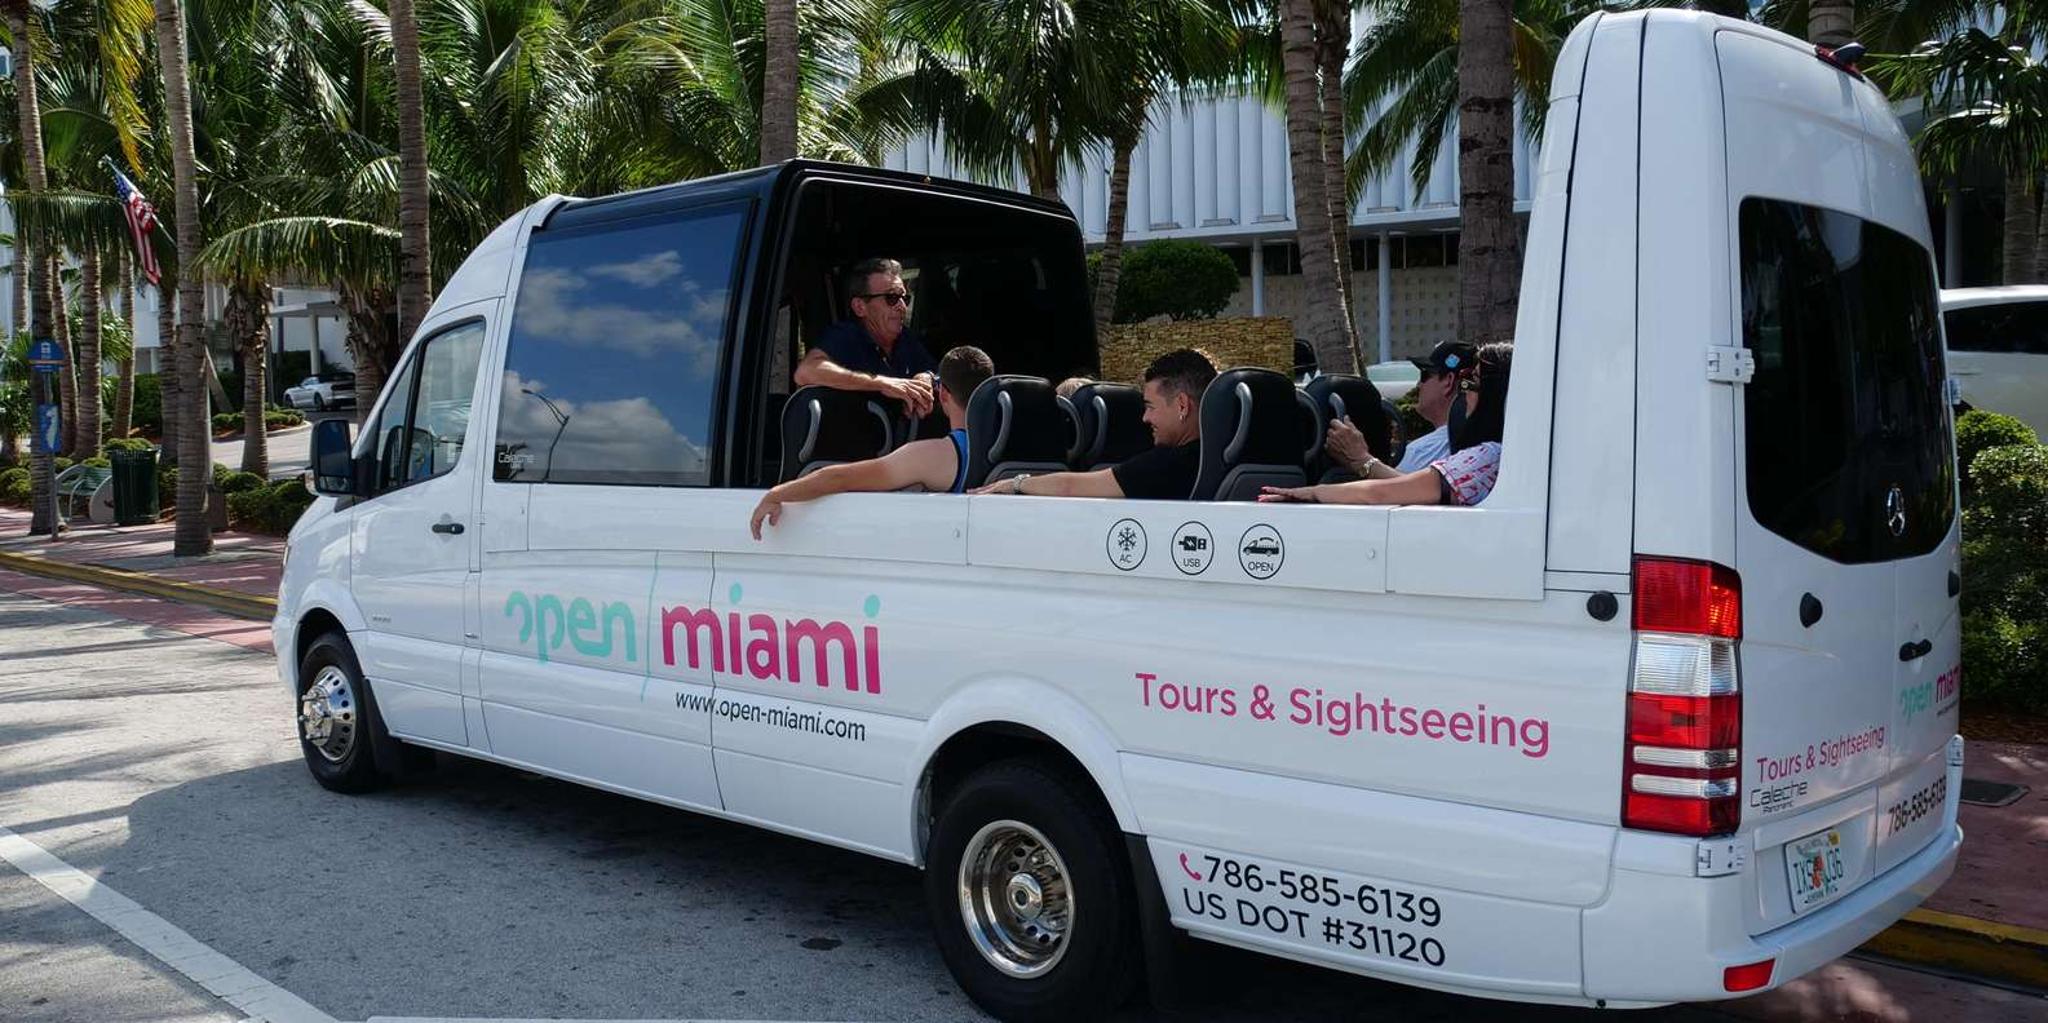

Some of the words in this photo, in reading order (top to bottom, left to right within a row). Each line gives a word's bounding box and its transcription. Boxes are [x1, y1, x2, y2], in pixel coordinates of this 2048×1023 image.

[1119, 553, 1132, 563] AC
[1183, 558, 1200, 568] USB
[1247, 561, 1274, 572] OPEN
[504, 590, 637, 665] open
[661, 582, 882, 694] miami
[675, 692, 867, 742] www.open-miami.com
[1135, 672, 1238, 717] Tours
[1249, 684, 1276, 721] &
[1288, 687, 1550, 759] Sightseeing
[1757, 757, 1801, 783] Tours
[1805, 745, 1816, 770] &
[1818, 725, 1885, 767] Sightseeing
[1750, 782, 1808, 808] Caleche
[1204, 856, 1441, 927] 786-585-6139
[1183, 887, 1227, 921] US
[1236, 899, 1310, 938] DOT
[1322, 916, 1446, 967] #31120
